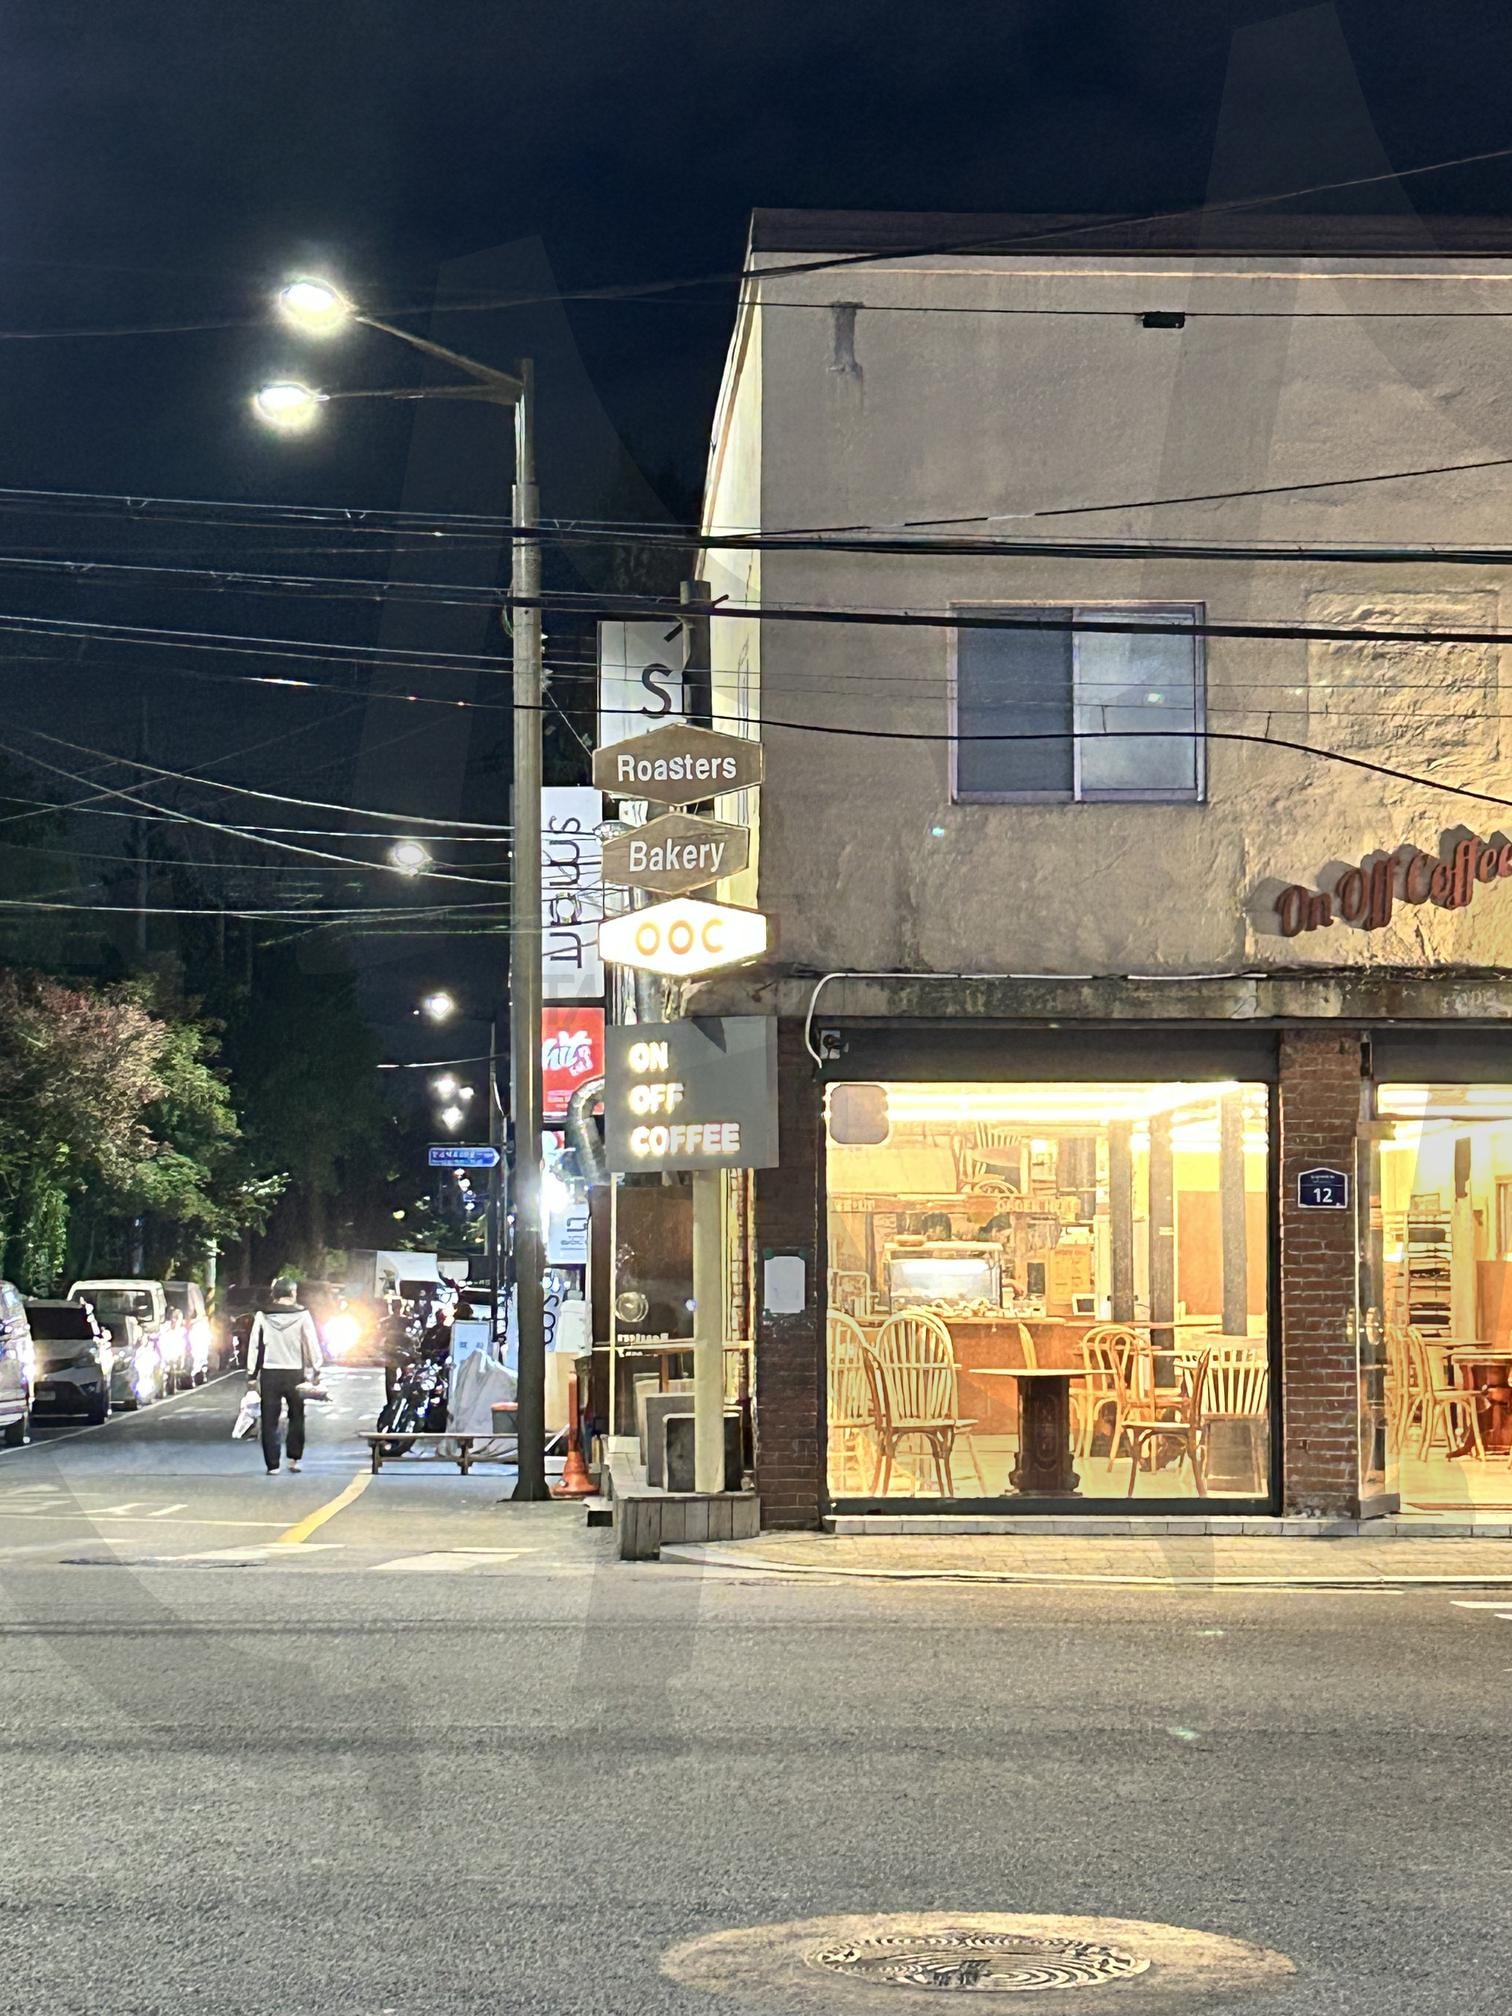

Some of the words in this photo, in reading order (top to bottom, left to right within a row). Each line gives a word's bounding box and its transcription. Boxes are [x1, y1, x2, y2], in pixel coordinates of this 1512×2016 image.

[617, 754, 736, 782] Roasters
[629, 838, 725, 872] Bakery
[1275, 885, 1334, 937] On
[1336, 856, 1400, 930] Off
[635, 916, 724, 956] OOC
[628, 1041, 669, 1074] ON
[628, 1083, 684, 1115] OFF
[629, 1122, 741, 1157] COFFEE
[1313, 1187, 1333, 1203] 12
